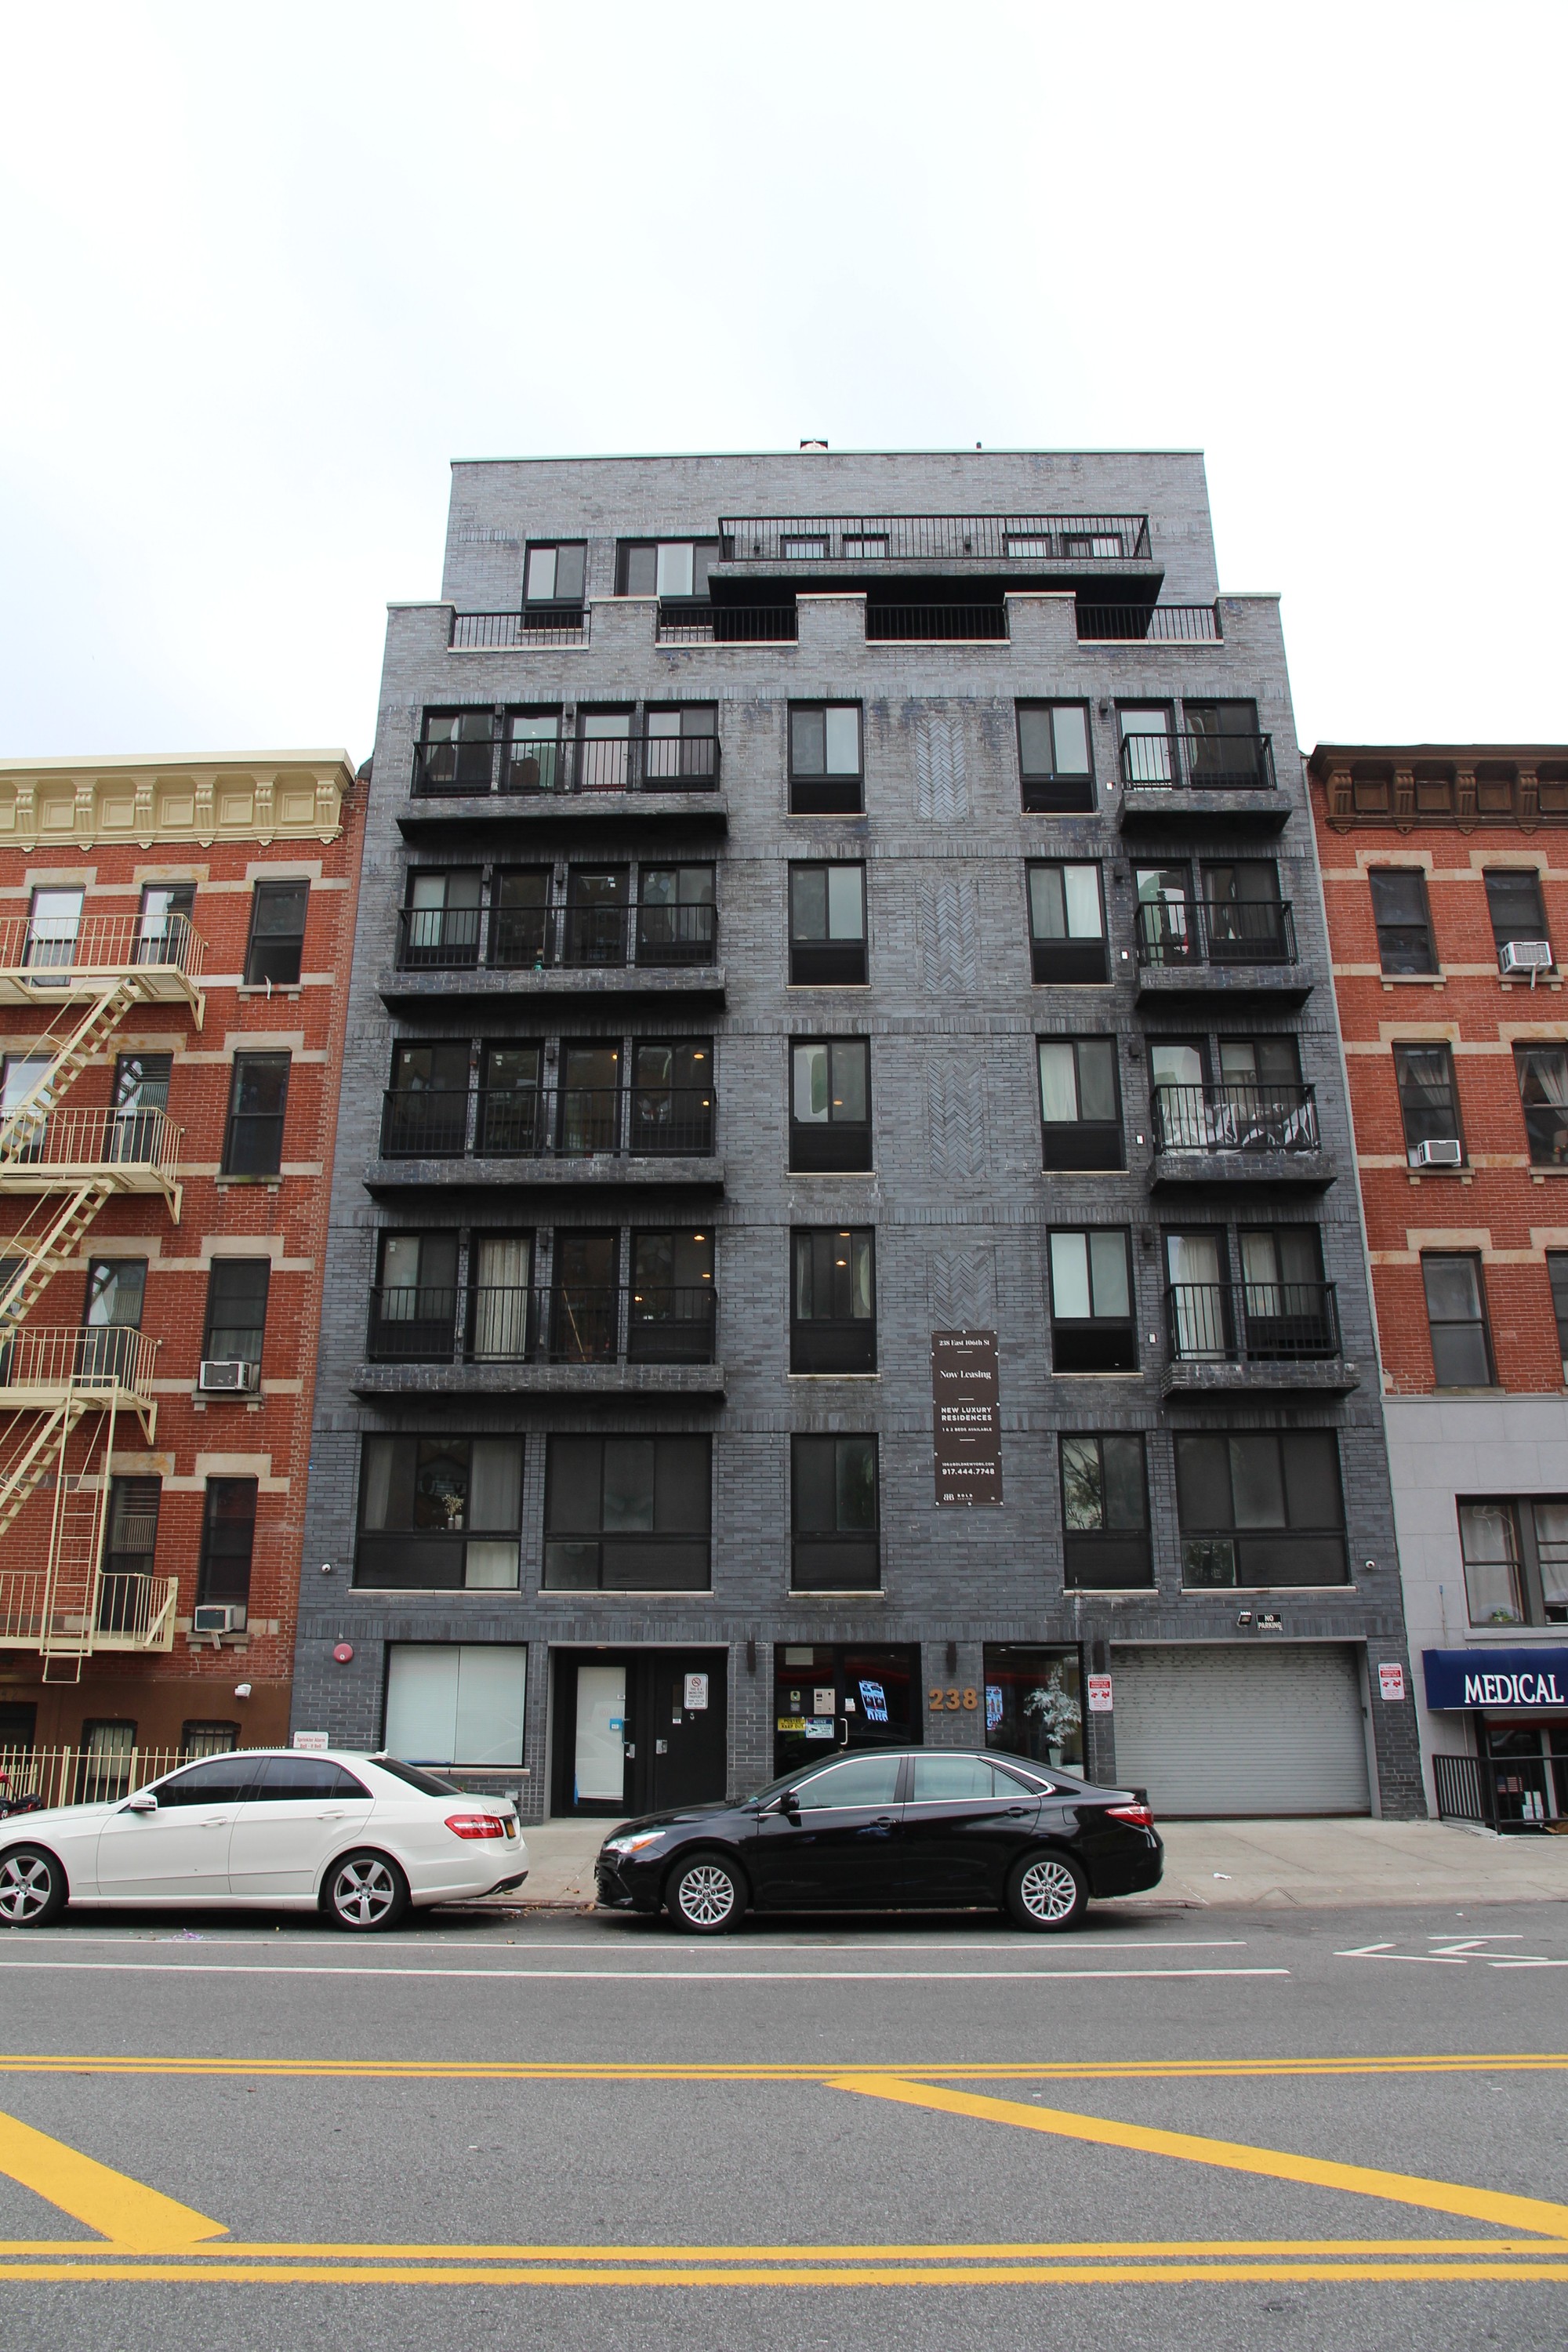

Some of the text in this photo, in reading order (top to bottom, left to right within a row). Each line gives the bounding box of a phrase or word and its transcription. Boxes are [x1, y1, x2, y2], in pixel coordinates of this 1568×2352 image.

[960, 1370, 992, 1380] Leasing
[928, 1688, 978, 1711] 238
[1464, 1673, 1565, 1704] MEDICAL
